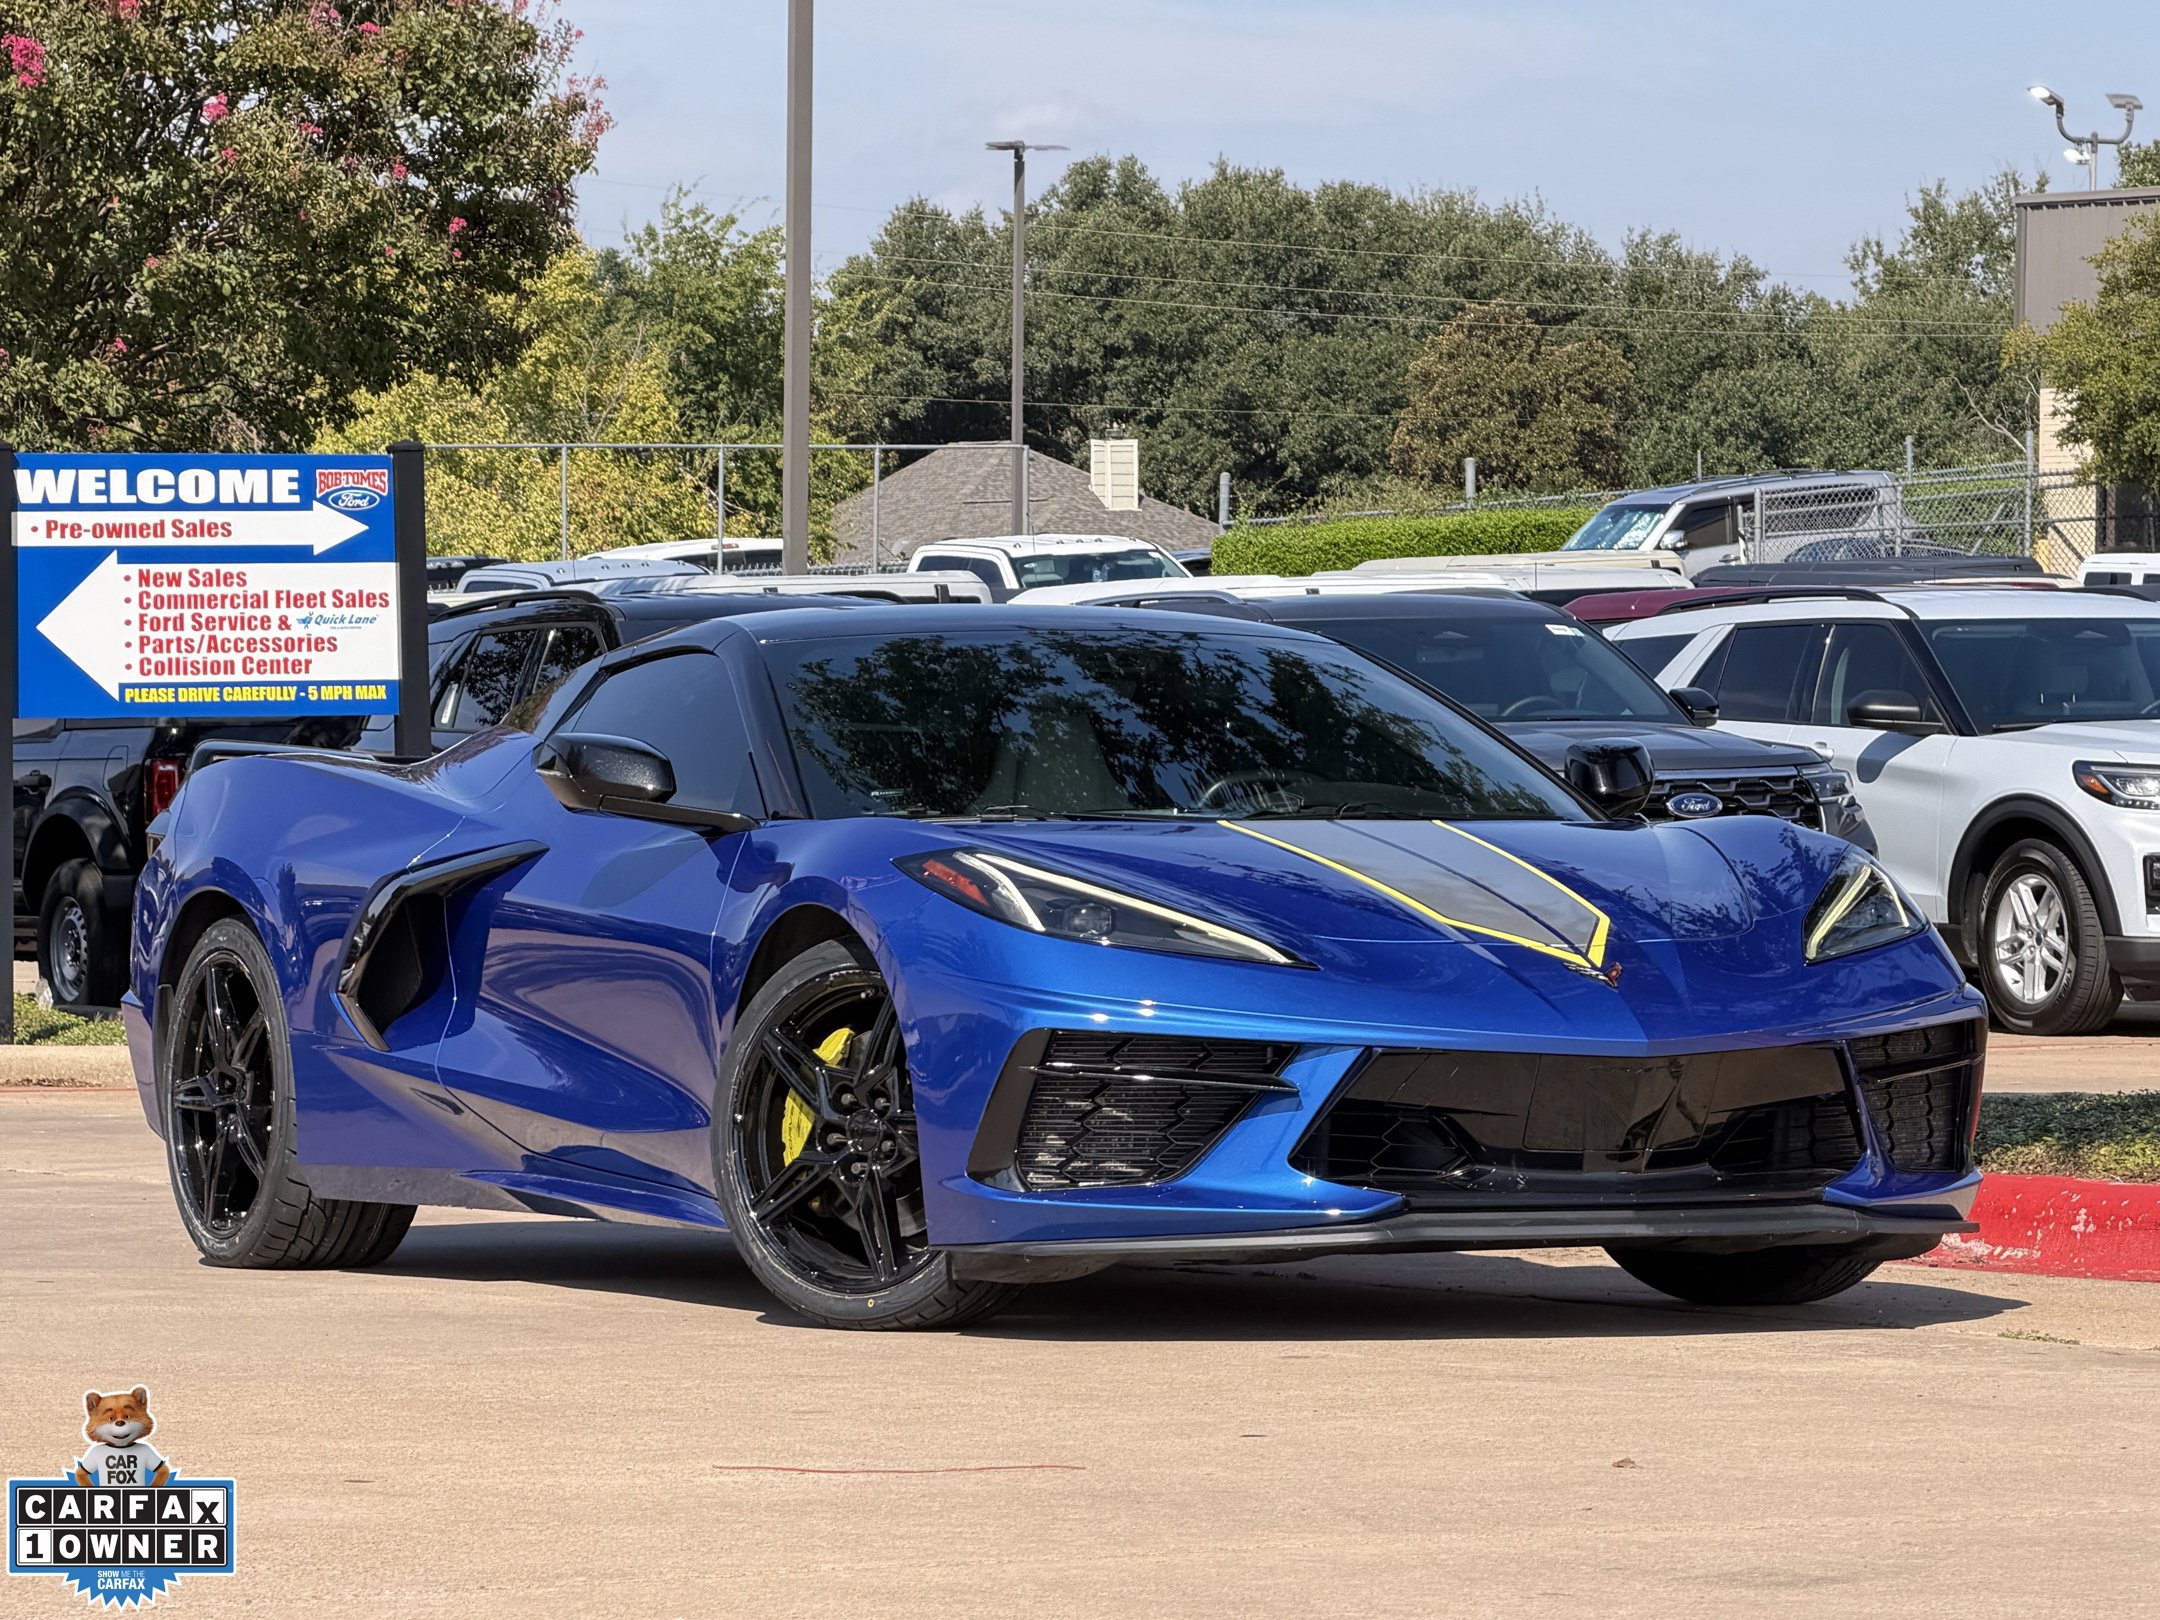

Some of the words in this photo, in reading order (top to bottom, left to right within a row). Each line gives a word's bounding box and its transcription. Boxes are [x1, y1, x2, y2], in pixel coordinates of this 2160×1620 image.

[13, 469, 300, 504] WELCOME
[338, 493, 370, 507] Ford
[45, 519, 166, 539] Pre-owned
[171, 518, 233, 538] Sales
[138, 568, 182, 588] New
[188, 568, 247, 588] Sales
[138, 590, 269, 610] Commercial
[275, 589, 327, 609] Fleet
[331, 588, 390, 609] Sales
[138, 612, 185, 632] Ford
[190, 611, 272, 632] Service
[277, 614, 292, 631] &
[314, 613, 347, 626] Quick
[347, 613, 377, 625] Lane
[138, 633, 338, 655] Parts/Accessories
[138, 656, 236, 676] Collision
[241, 655, 313, 676] Center
[125, 688, 175, 703] PLEASE
[177, 688, 221, 702] DRIVE
[222, 686, 298, 702] CAREFULLY
[308, 686, 318, 701] 5
[320, 686, 352, 700] MPH
[355, 685, 387, 700] MAX
[1681, 798, 1711, 812] Ford
